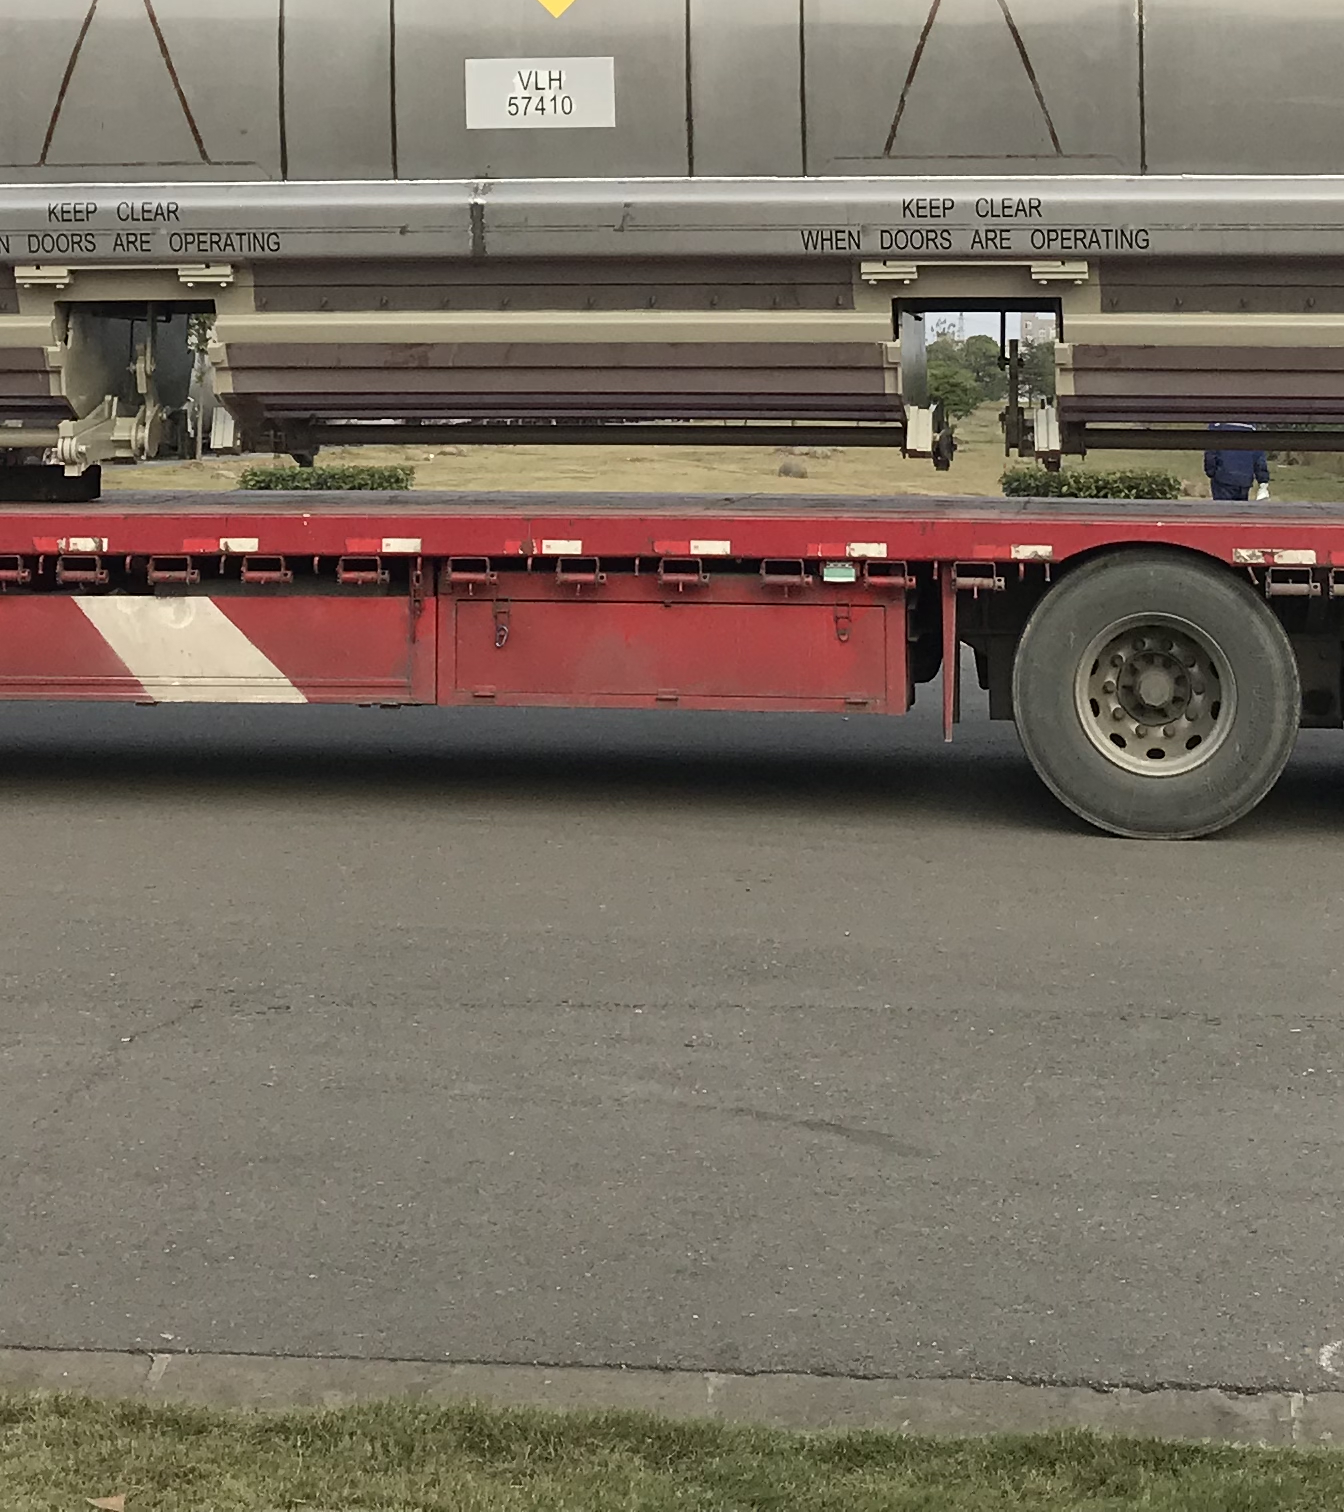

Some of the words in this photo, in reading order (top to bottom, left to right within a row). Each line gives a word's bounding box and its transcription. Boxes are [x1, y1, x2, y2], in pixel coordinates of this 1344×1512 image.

[517, 70, 562, 90] VLH
[507, 95, 573, 116] 57410
[47, 202, 98, 222] KEEP
[116, 201, 180, 222] CLEAR
[902, 198, 955, 218] KEEP
[975, 197, 1043, 218] CLEAR
[27, 233, 97, 254] DOORS
[112, 233, 152, 253] ARE
[169, 232, 281, 253] OPERATING
[800, 230, 861, 251] WHEN
[879, 229, 953, 250] DOORS
[970, 229, 1012, 250] ARE
[1031, 228, 1150, 250] OPERATING
